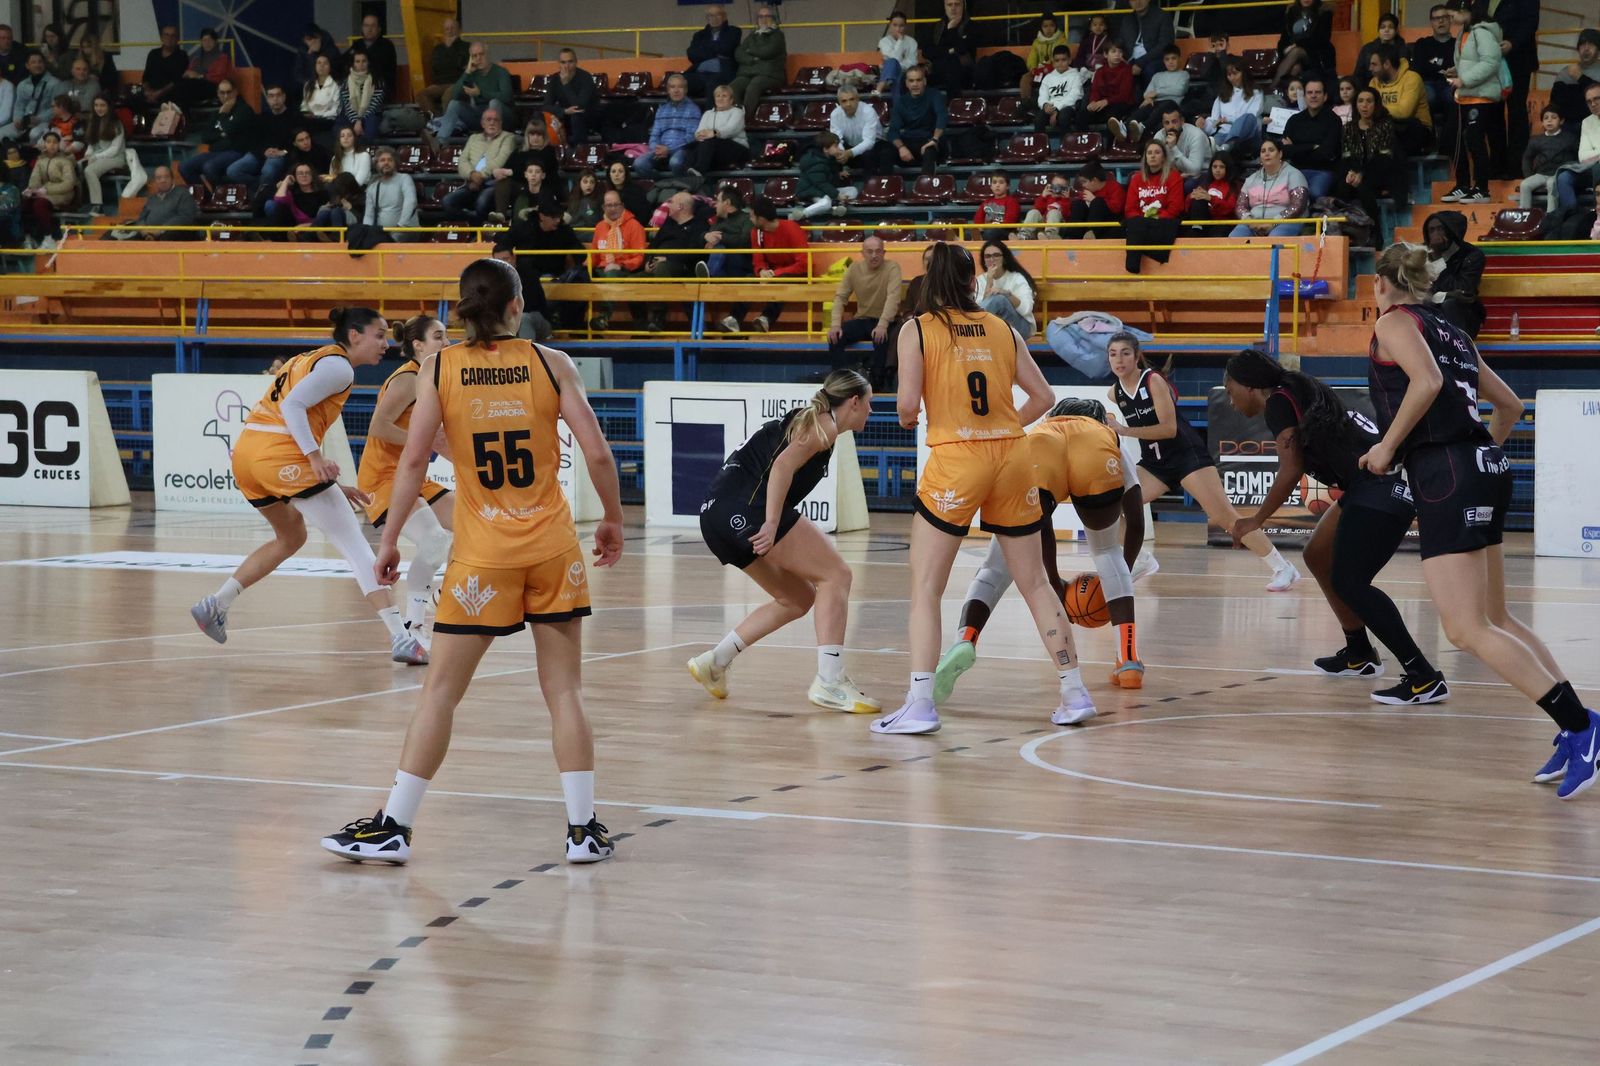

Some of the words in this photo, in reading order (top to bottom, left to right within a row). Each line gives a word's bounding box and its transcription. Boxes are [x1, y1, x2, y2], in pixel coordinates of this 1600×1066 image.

[821, 104, 827, 113] 1
[964, 101, 972, 111] 7
[1023, 136, 1034, 146] 11
[881, 179, 889, 189] 7
[932, 177, 940, 187] 9
[460, 365, 531, 386] CARREGOSA
[967, 370, 990, 417] 9
[487, 408, 527, 418] ZAMORA
[761, 399, 787, 418] LUIS
[1148, 441, 1161, 460] 7
[472, 429, 535, 491] 55
[34, 469, 80, 480] CRUCES
[164, 495, 194, 503] SALUD
